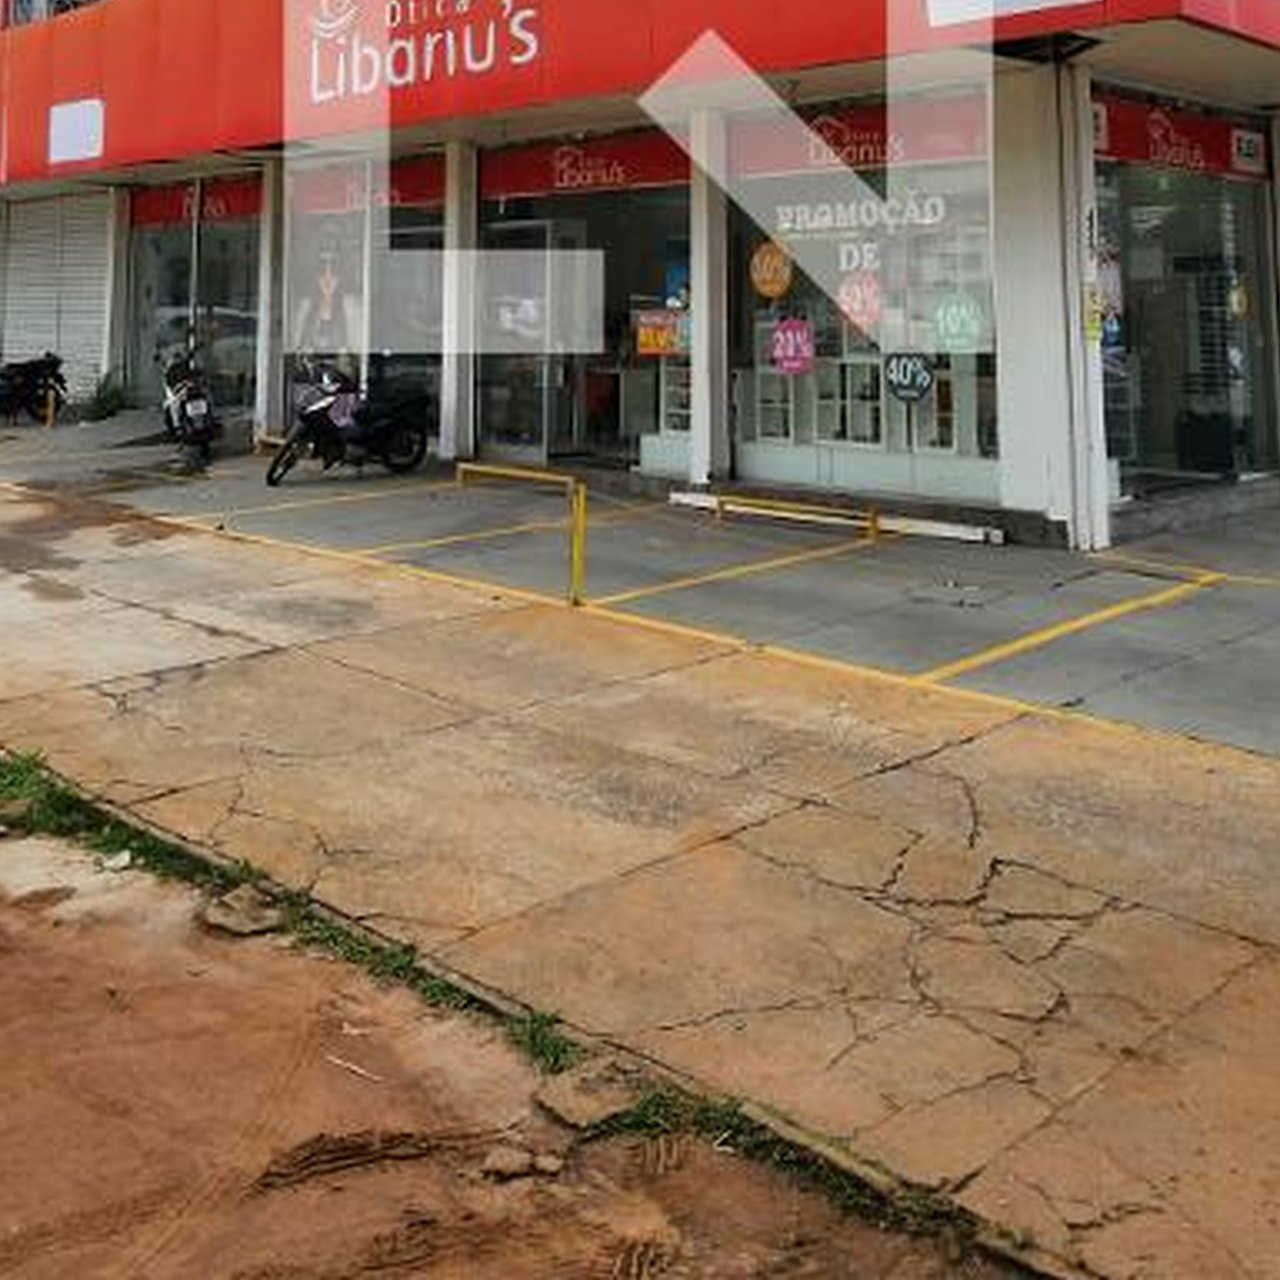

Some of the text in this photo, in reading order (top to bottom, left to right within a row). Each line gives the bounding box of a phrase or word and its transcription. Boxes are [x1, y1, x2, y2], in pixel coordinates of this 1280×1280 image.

[776, 188, 946, 235] PROMOÇÃO
[839, 242, 881, 271] DE
[886, 355, 931, 388] 40%
